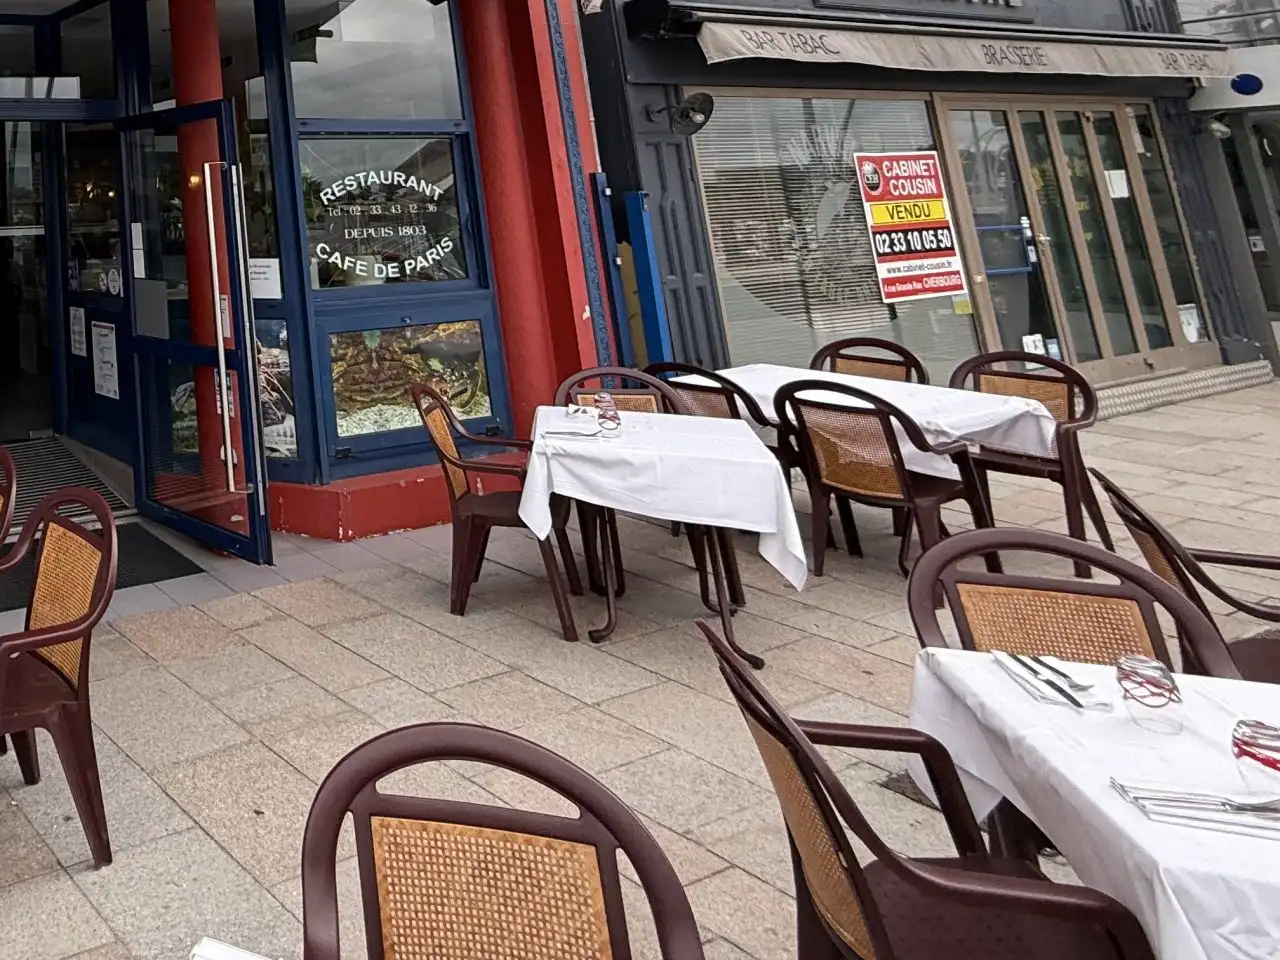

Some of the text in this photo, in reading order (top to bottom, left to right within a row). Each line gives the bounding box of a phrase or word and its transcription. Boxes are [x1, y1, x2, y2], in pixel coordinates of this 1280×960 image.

[740, 29, 840, 55] BAR TABAC
[981, 43, 1049, 67] BRASSERIE
[882, 159, 936, 178] CABINET
[320, 169, 445, 206] RESTAURANT
[889, 177, 937, 196] COUSIN
[885, 203, 931, 221] VENDU
[344, 225, 427, 240] DEPUIS 1803
[876, 229, 952, 254] 02 33 10 05 50
[316, 236, 454, 279] CAFE DE PARIS
[886, 259, 953, 275] www.cabinet-cousin.fr
[922, 274, 962, 289] CHERBOURG
